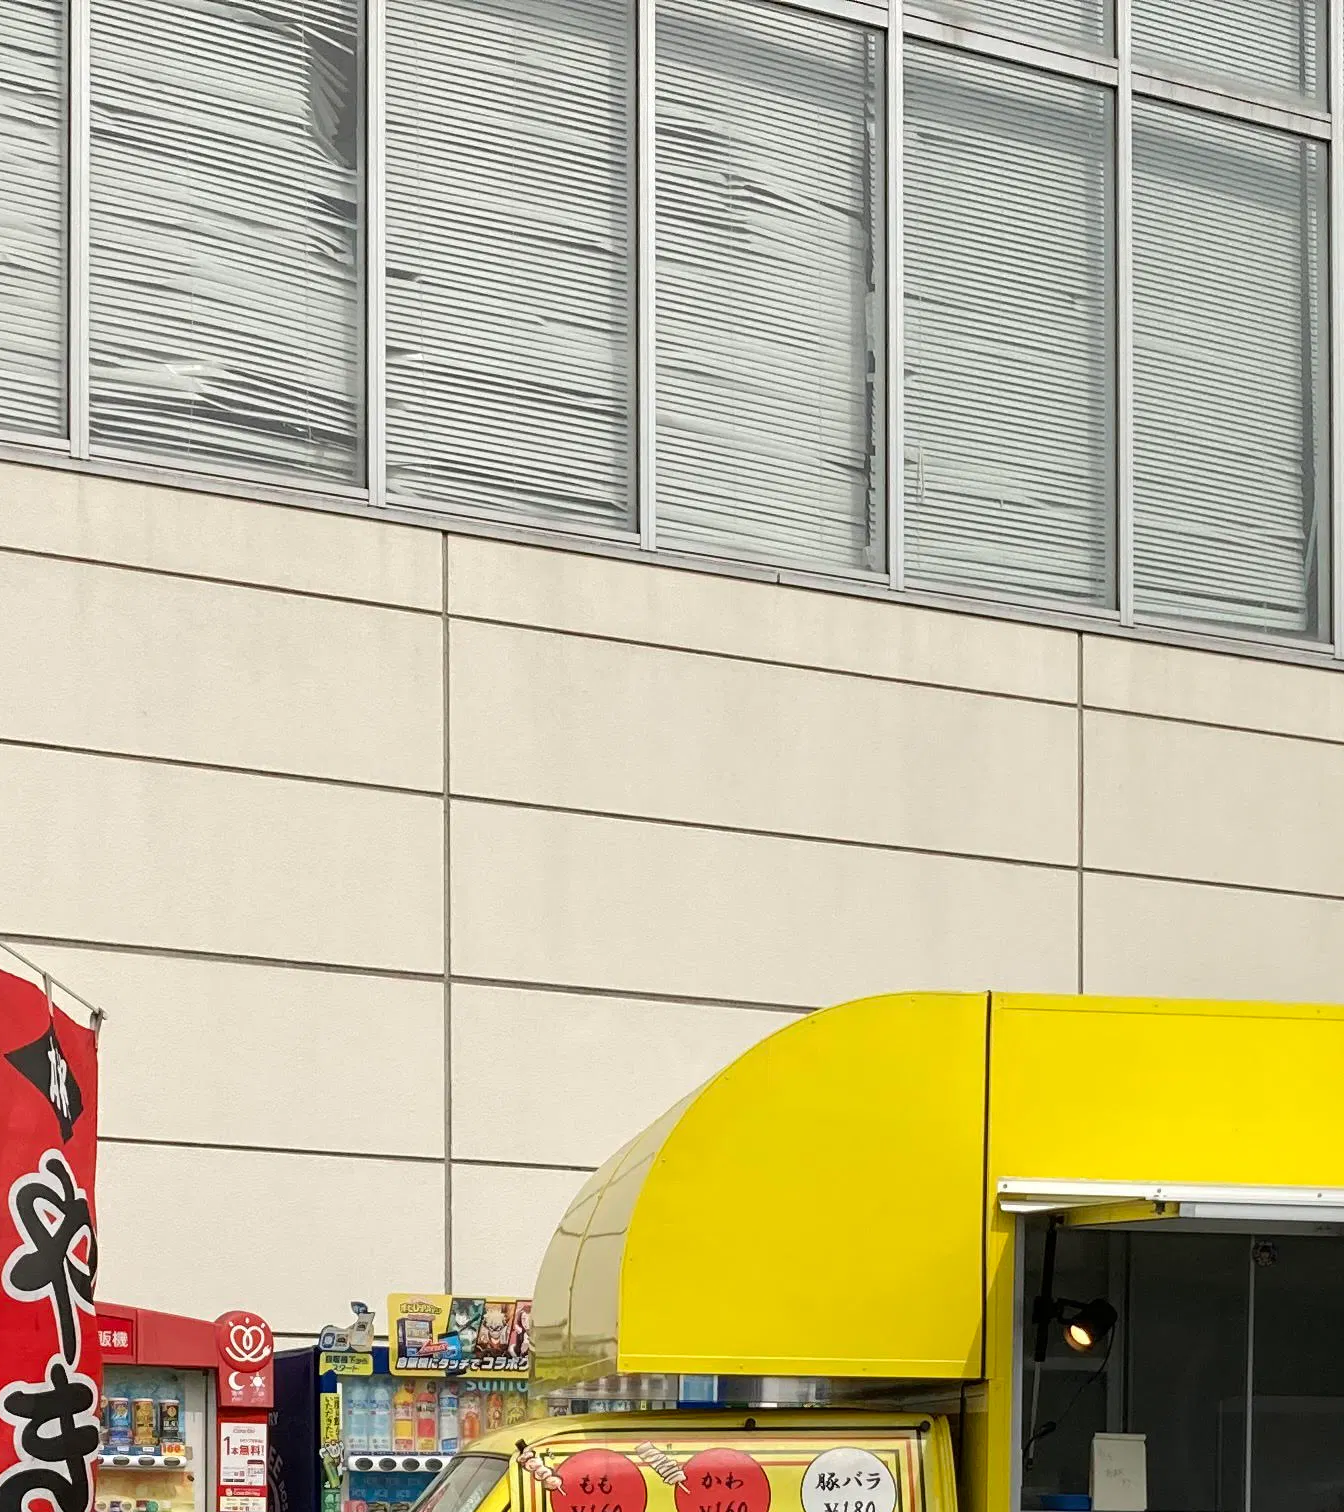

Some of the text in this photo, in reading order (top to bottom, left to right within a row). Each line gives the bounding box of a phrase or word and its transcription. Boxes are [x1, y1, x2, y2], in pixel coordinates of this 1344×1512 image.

[578, 1474, 612, 1494] もも
[701, 1473, 744, 1490] かわ
[815, 1470, 882, 1491] 豚バラ
